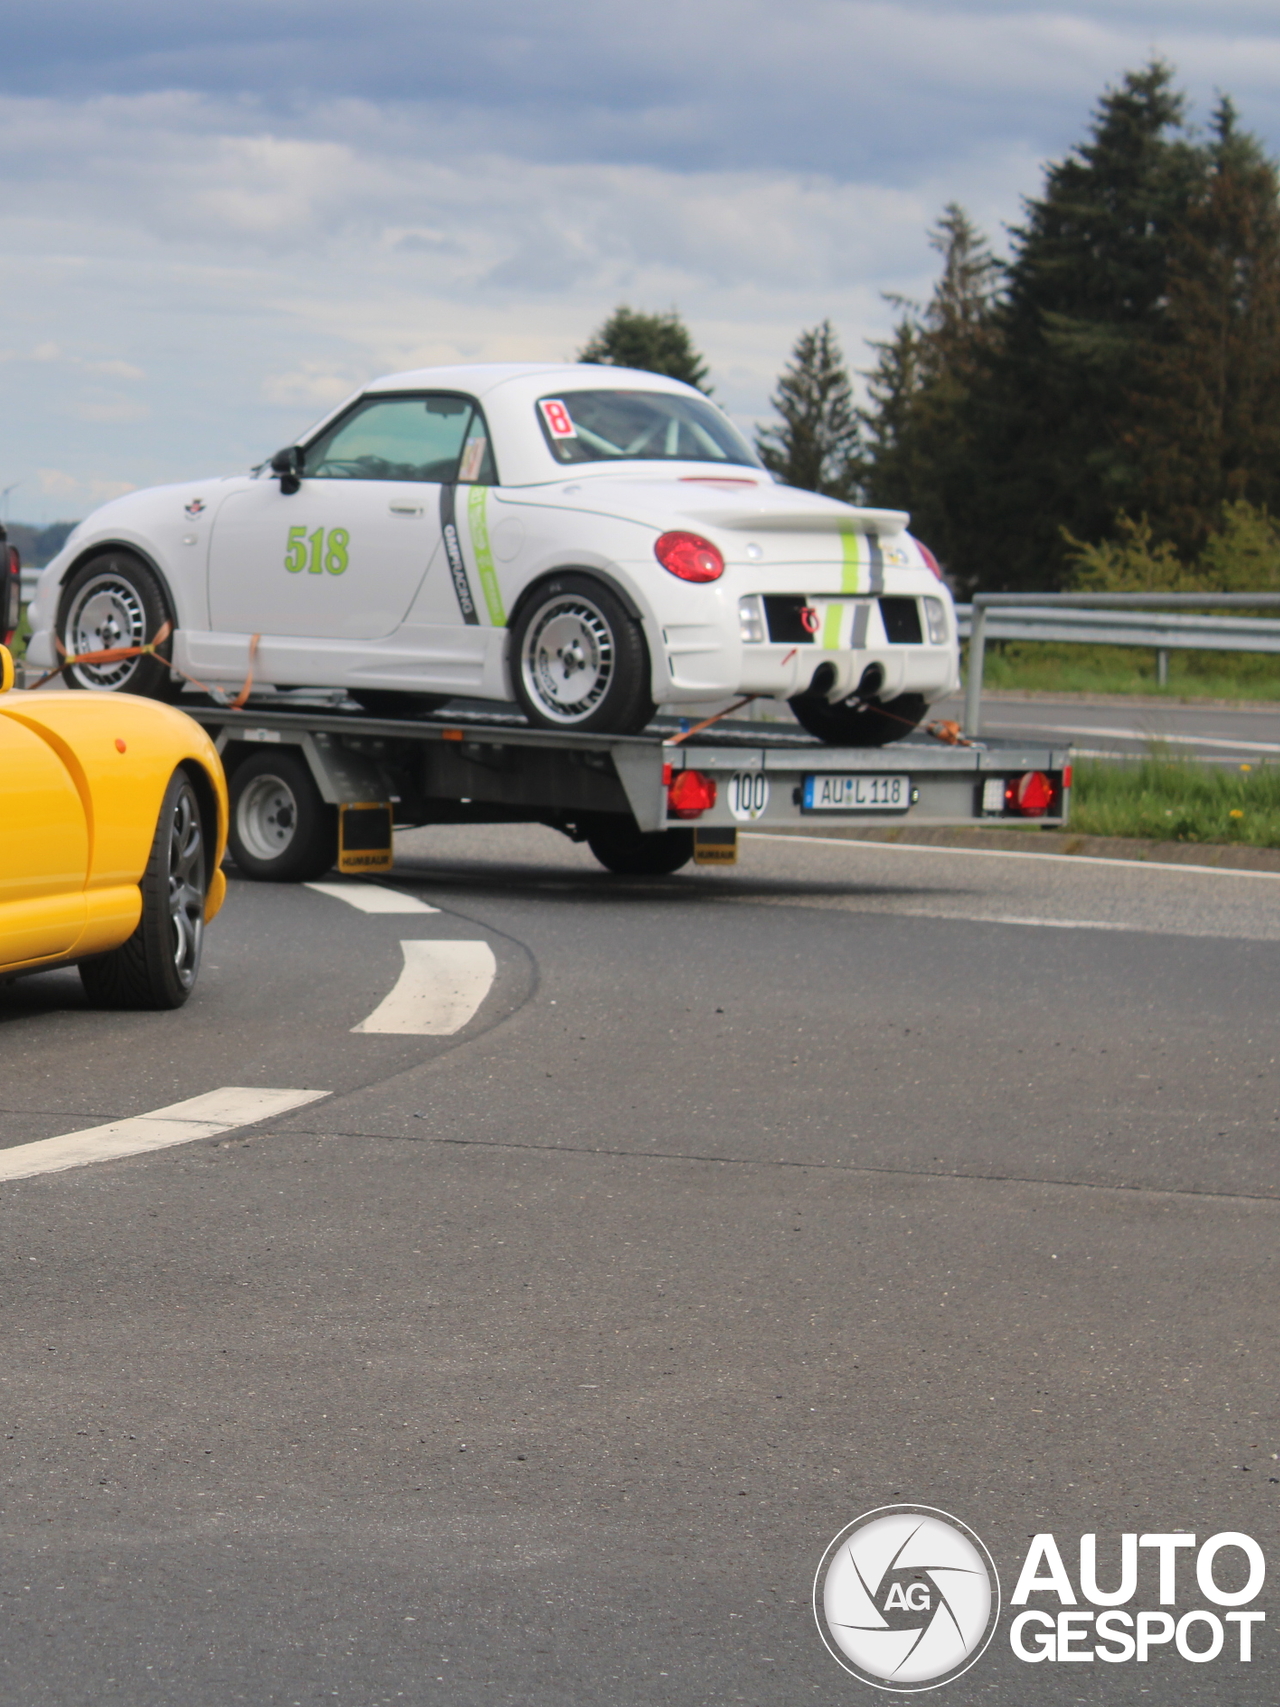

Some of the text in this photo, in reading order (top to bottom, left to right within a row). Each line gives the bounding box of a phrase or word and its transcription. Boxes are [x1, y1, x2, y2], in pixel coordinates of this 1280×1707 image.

[544, 403, 572, 433] 8
[284, 525, 350, 575] 518
[734, 771, 765, 811] 100
[821, 779, 901, 803] AU L 118
[342, 855, 389, 866] HUMBAUR
